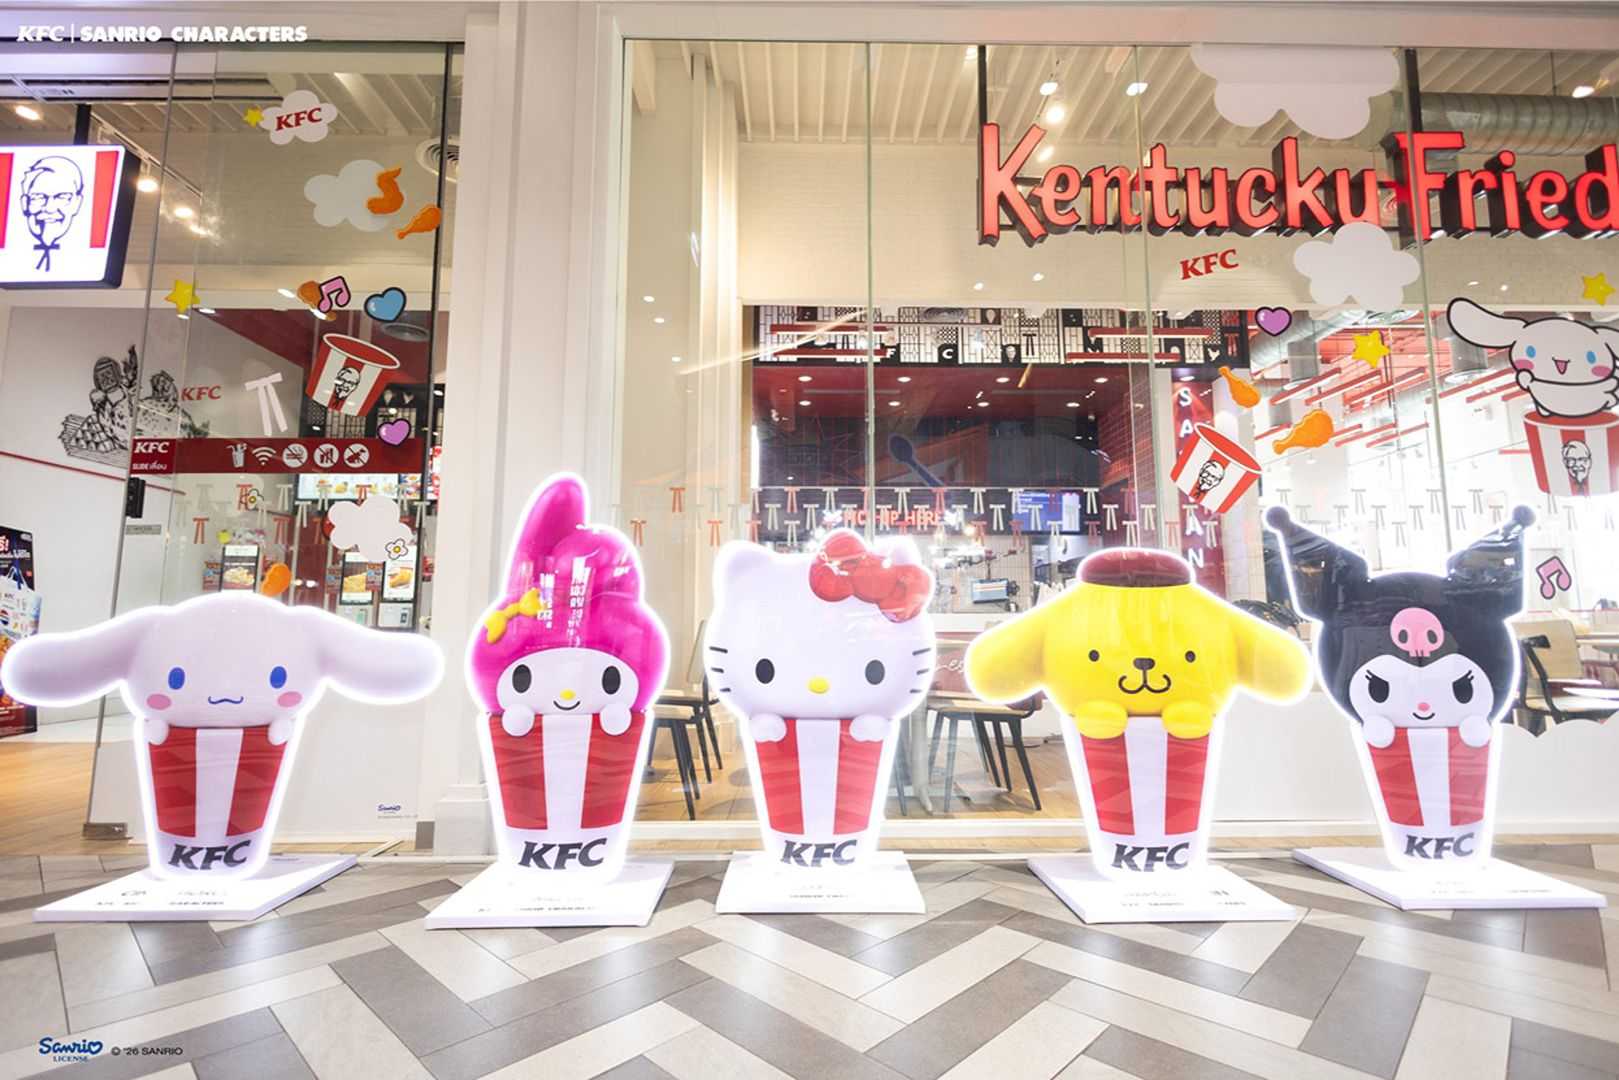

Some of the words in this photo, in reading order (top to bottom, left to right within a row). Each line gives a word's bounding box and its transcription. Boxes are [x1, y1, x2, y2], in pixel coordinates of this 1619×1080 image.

[275, 107, 323, 131] KFC
[1393, 131, 1619, 242] Fried
[1180, 248, 1239, 280] KFC
[181, 385, 222, 401] KFC
[133, 441, 170, 454] KFC
[1178, 386, 1206, 568] SAAN
[167, 839, 252, 871] KFC
[517, 837, 608, 870] KFC
[780, 839, 857, 868] KFC
[1111, 841, 1190, 872] KFC
[1404, 832, 1475, 859] KFC
